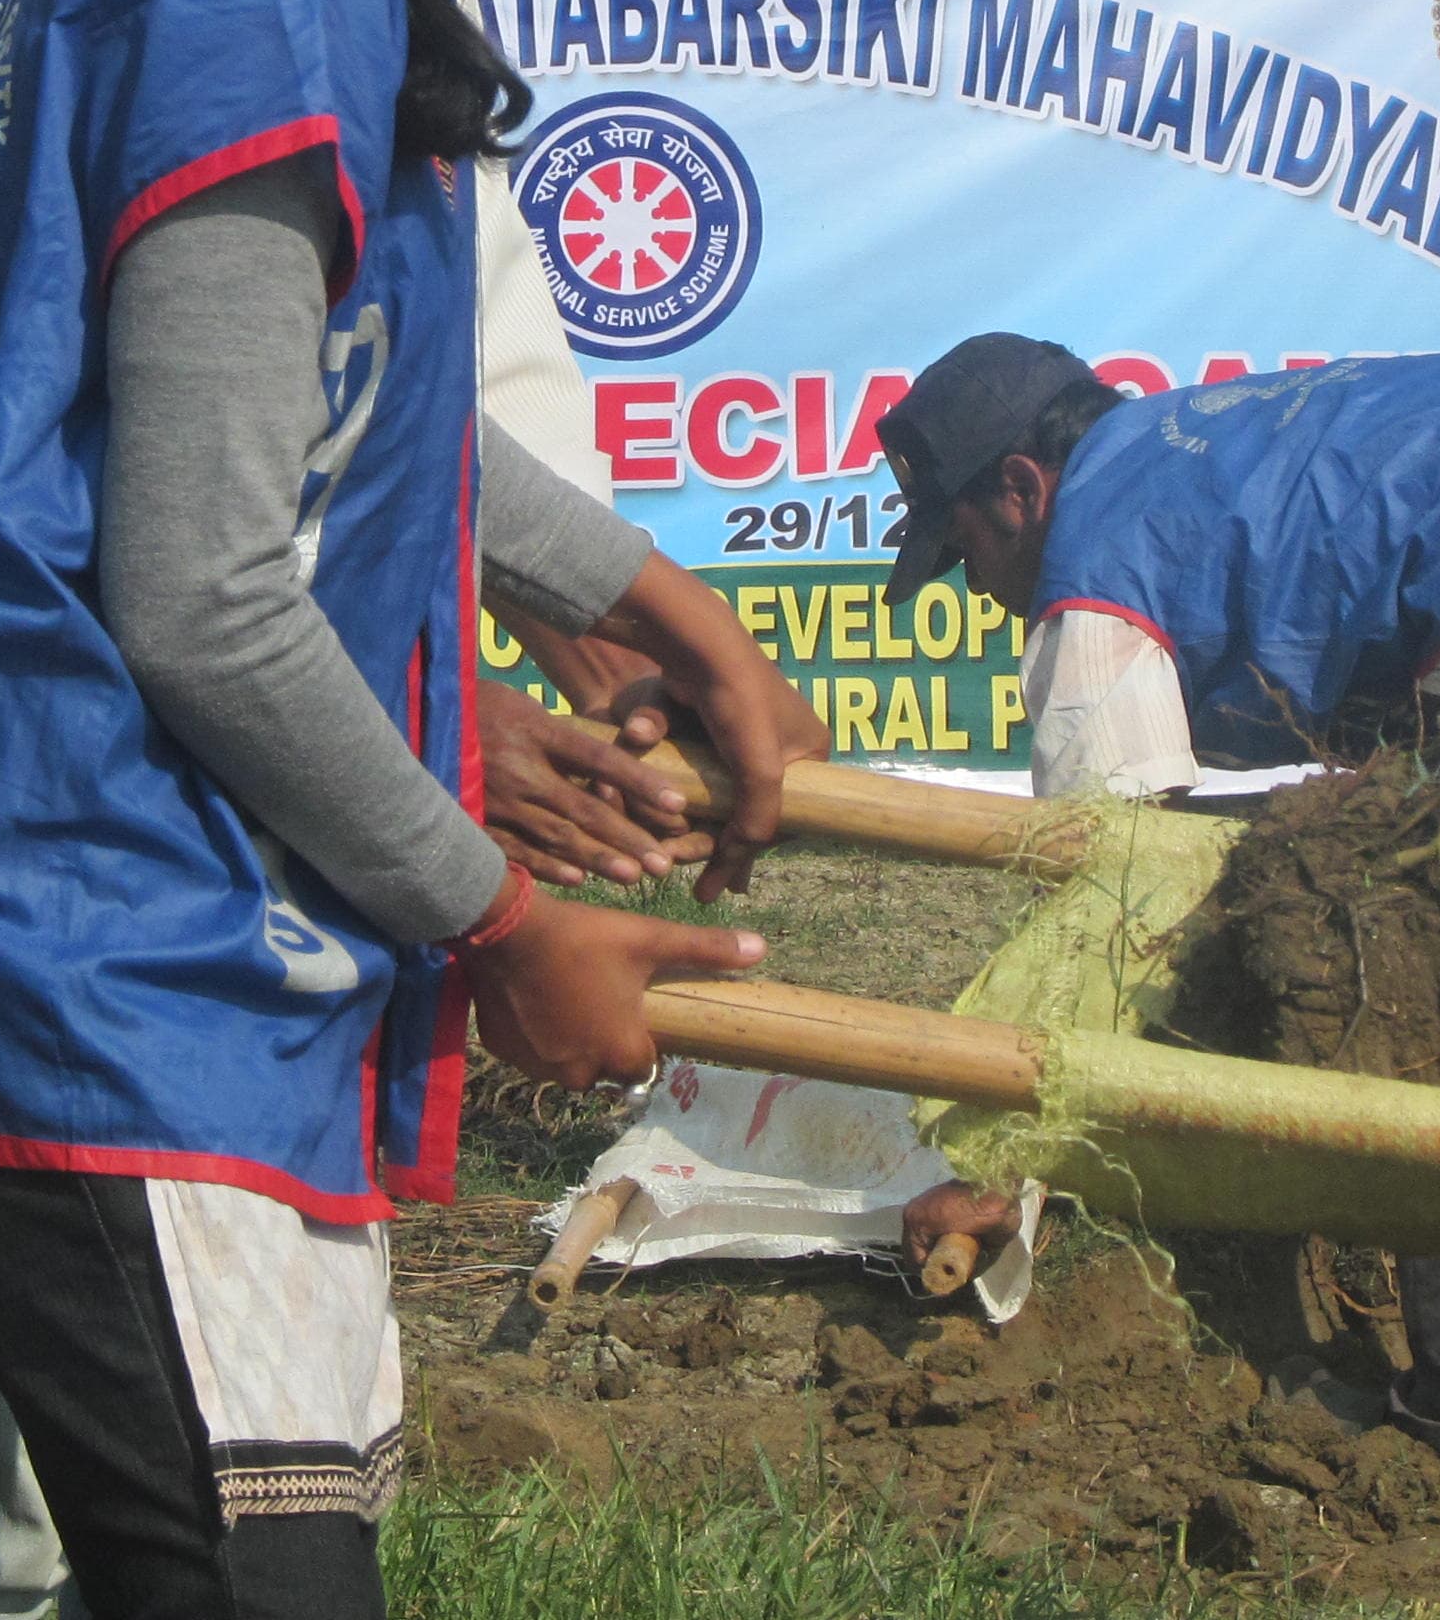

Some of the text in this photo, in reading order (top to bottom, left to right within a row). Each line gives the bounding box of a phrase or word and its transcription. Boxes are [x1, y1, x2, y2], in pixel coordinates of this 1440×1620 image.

[598, 121, 654, 149] सेवा
[662, 134, 723, 203] योजना
[593, 296, 682, 327] SERVICE
[679, 224, 729, 304] SCHEME
